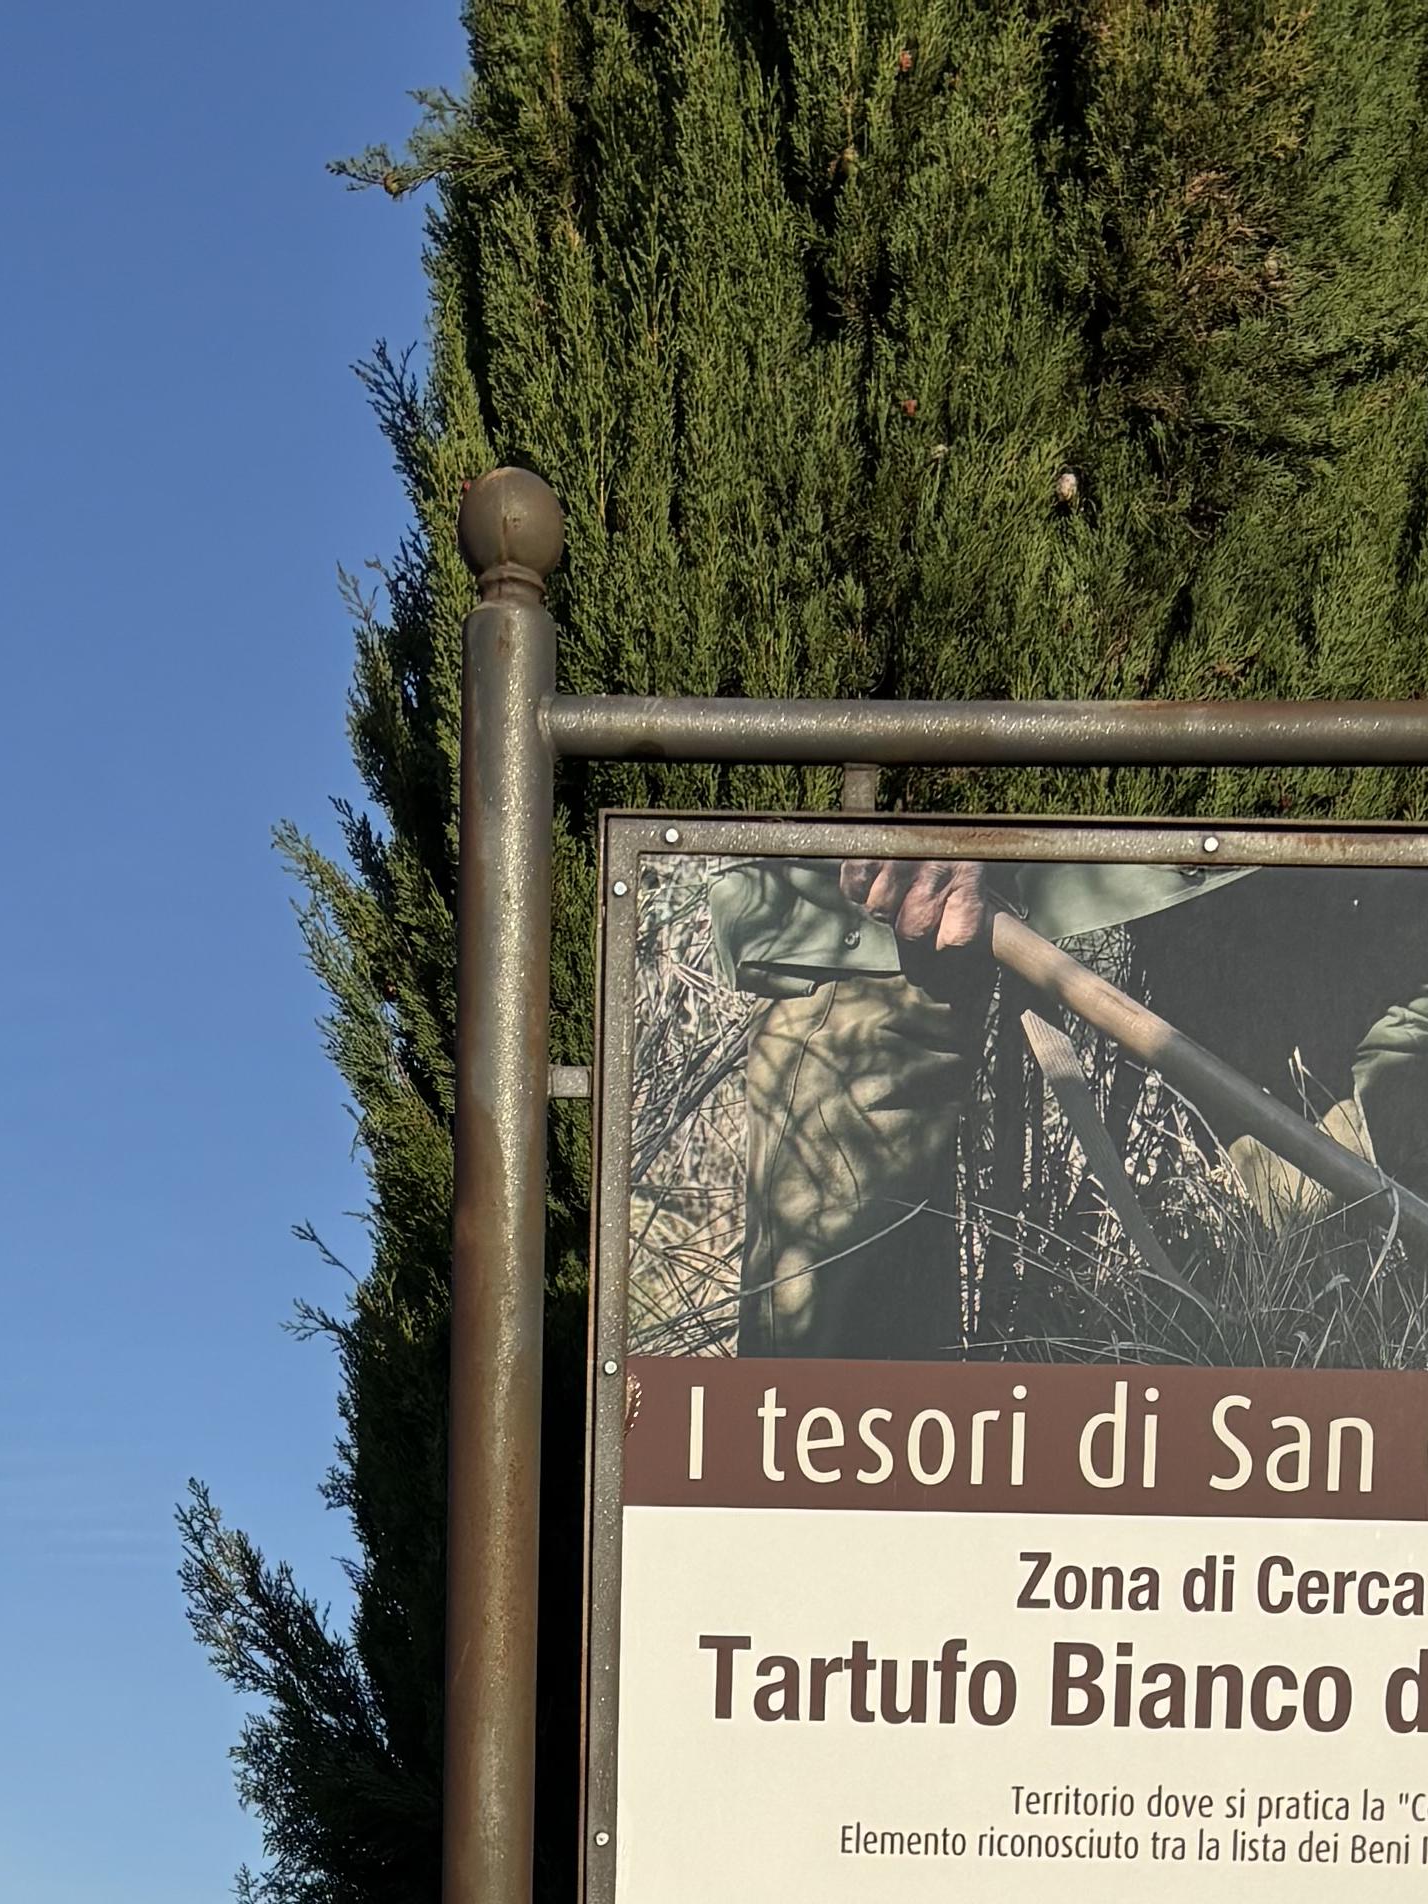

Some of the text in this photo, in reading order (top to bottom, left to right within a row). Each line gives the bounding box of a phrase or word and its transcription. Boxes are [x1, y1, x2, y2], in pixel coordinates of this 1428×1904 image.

[689, 1386, 704, 1479] I
[757, 1384, 1027, 1485] tesori
[1079, 1384, 1159, 1488] di
[1209, 1394, 1373, 1492] San
[1016, 1551, 1159, 1611] Zona
[1182, 1554, 1234, 1612] di
[1257, 1555, 1424, 1616] Cerca
[698, 1634, 1016, 1726] Tartufo
[1050, 1641, 1352, 1732] Bianco
[1011, 1784, 1134, 1816] Territorio
[1146, 1784, 1214, 1819] dove
[1224, 1788, 1246, 1819] si
[1257, 1789, 1349, 1828] pratica
[1362, 1788, 1384, 1821] la
[841, 1822, 966, 1856] Elemento
[978, 1825, 1138, 1859] riconosciuto
[1151, 1831, 1185, 1860] tra
[1198, 1827, 1219, 1861] la
[1232, 1828, 1285, 1862] lista
[1298, 1830, 1338, 1863] dei
[1351, 1833, 1409, 1864] Beni
